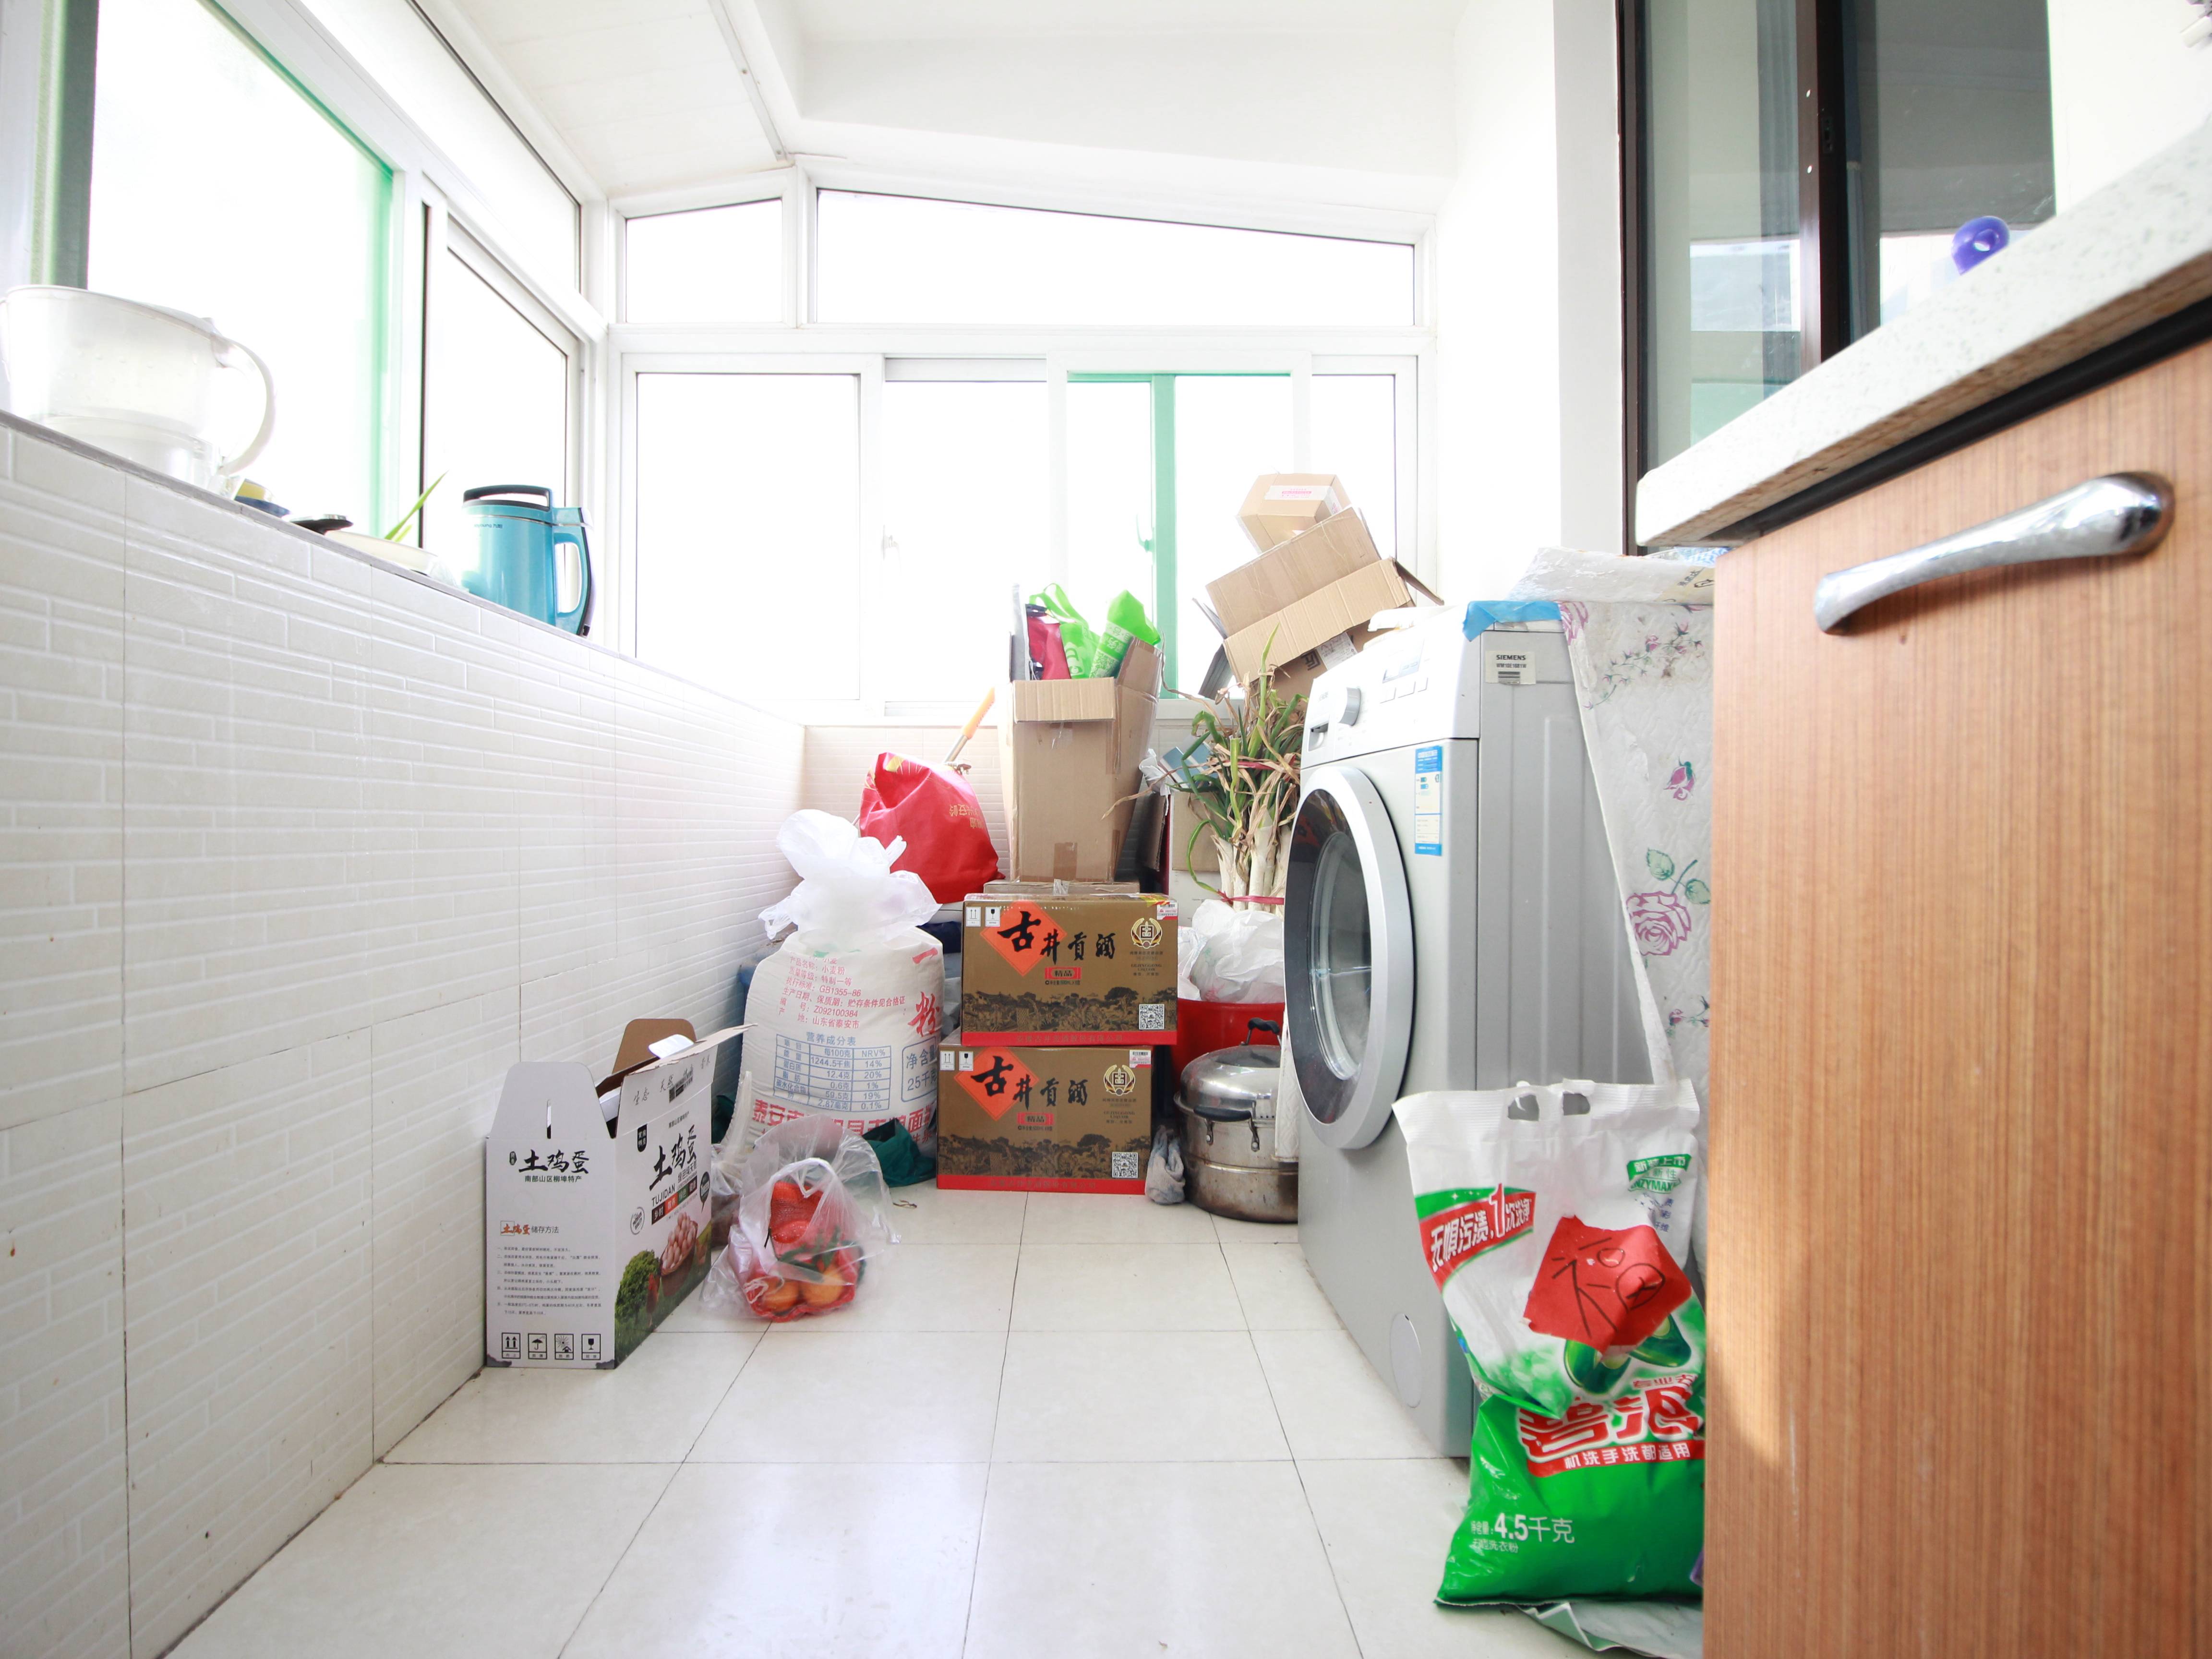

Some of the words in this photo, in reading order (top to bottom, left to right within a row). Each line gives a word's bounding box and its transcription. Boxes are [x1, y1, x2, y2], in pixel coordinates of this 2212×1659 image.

[997, 911, 1116, 965] 古井贡酒
[806, 1032, 856, 1046] 营养成分表
[811, 1056, 850, 1068] 1244.5千焦
[825, 1048, 851, 1058] 每100克
[827, 1070, 850, 1079] 12.4克
[971, 1056, 1088, 1110] 古井贡酒
[830, 1081, 850, 1090] 0.6克
[825, 1091, 849, 1100] 59.5克
[518, 1149, 589, 1174] 土鸡蛋
[649, 1124, 697, 1190] 土鸡蛋
[652, 1183, 675, 1207] TUJIDAN
[1563, 1442, 1691, 1469] 机洗手洗都适用
